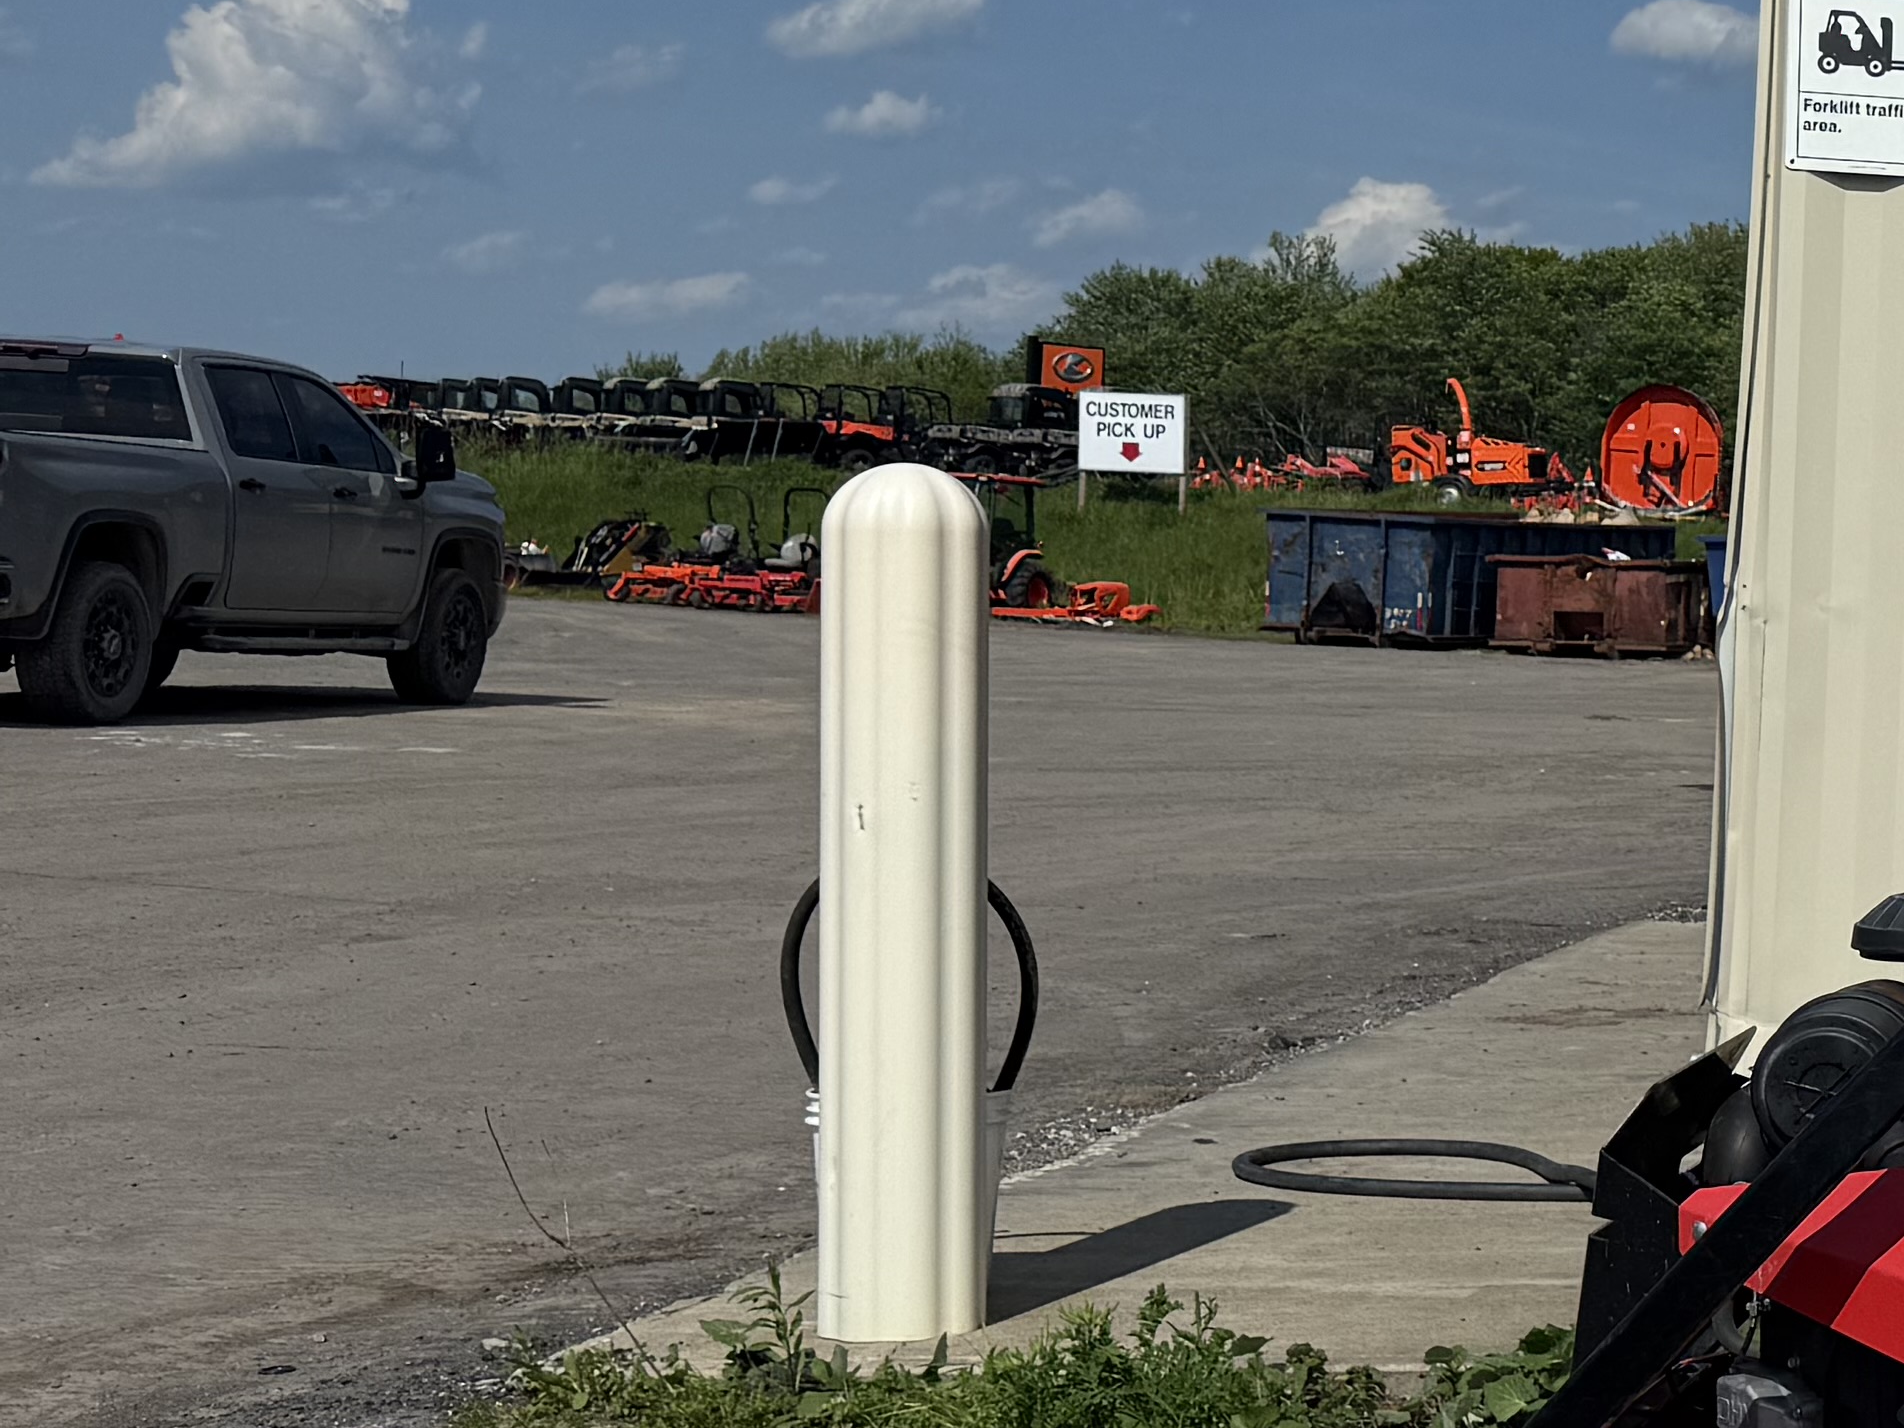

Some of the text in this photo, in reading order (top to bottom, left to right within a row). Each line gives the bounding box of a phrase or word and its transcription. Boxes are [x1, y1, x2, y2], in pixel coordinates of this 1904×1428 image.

[1803, 97, 1861, 115] Forklift
[1802, 120, 1842, 133] area.
[1086, 401, 1175, 419] CUSTOMER
[1096, 421, 1166, 439] PICK UP
